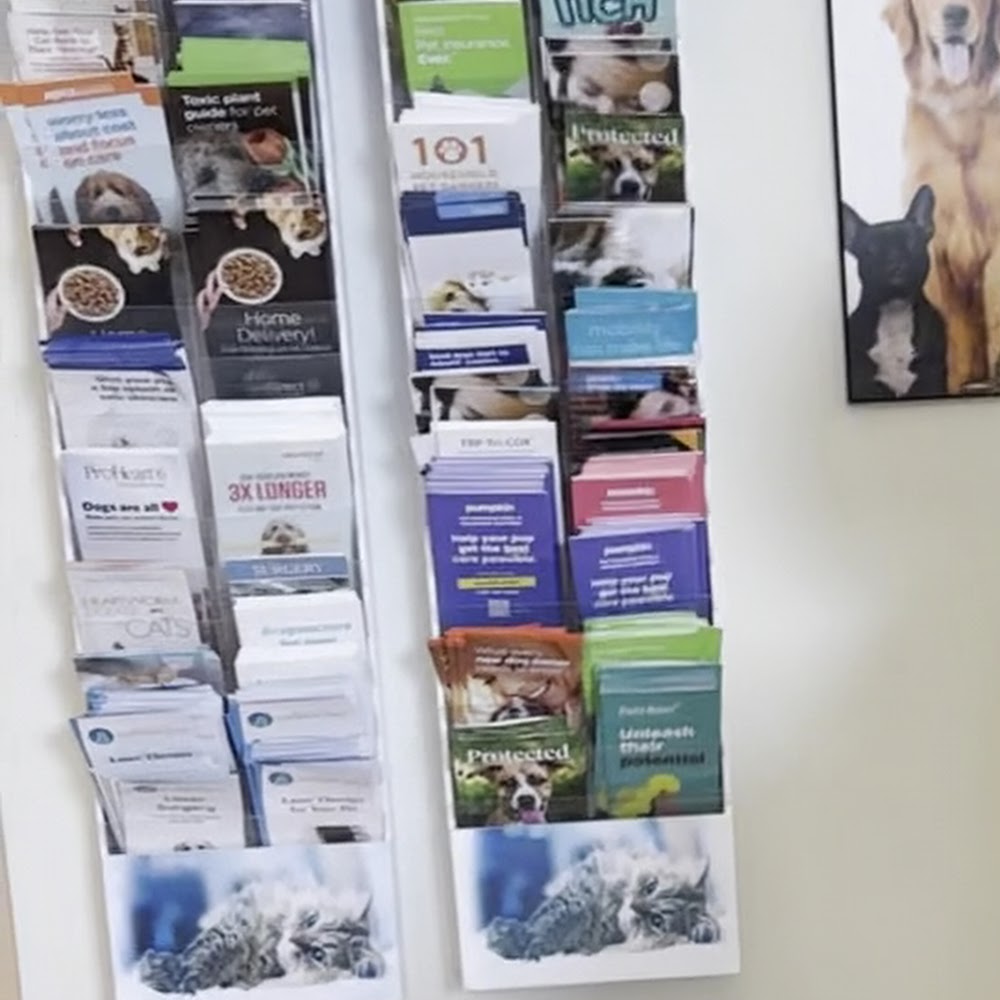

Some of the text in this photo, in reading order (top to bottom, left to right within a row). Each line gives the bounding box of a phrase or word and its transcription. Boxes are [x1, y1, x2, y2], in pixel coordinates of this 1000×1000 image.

[571, 124, 679, 145] Protected
[412, 135, 487, 166] 101
[244, 311, 302, 326] Home
[236, 327, 317, 345] Delivery!
[228, 479, 327, 502] 3X LONGER
[82, 501, 117, 514] Dogs
[126, 618, 192, 639] CATS
[467, 743, 571, 764] Protected
[619, 751, 706, 770] potential
